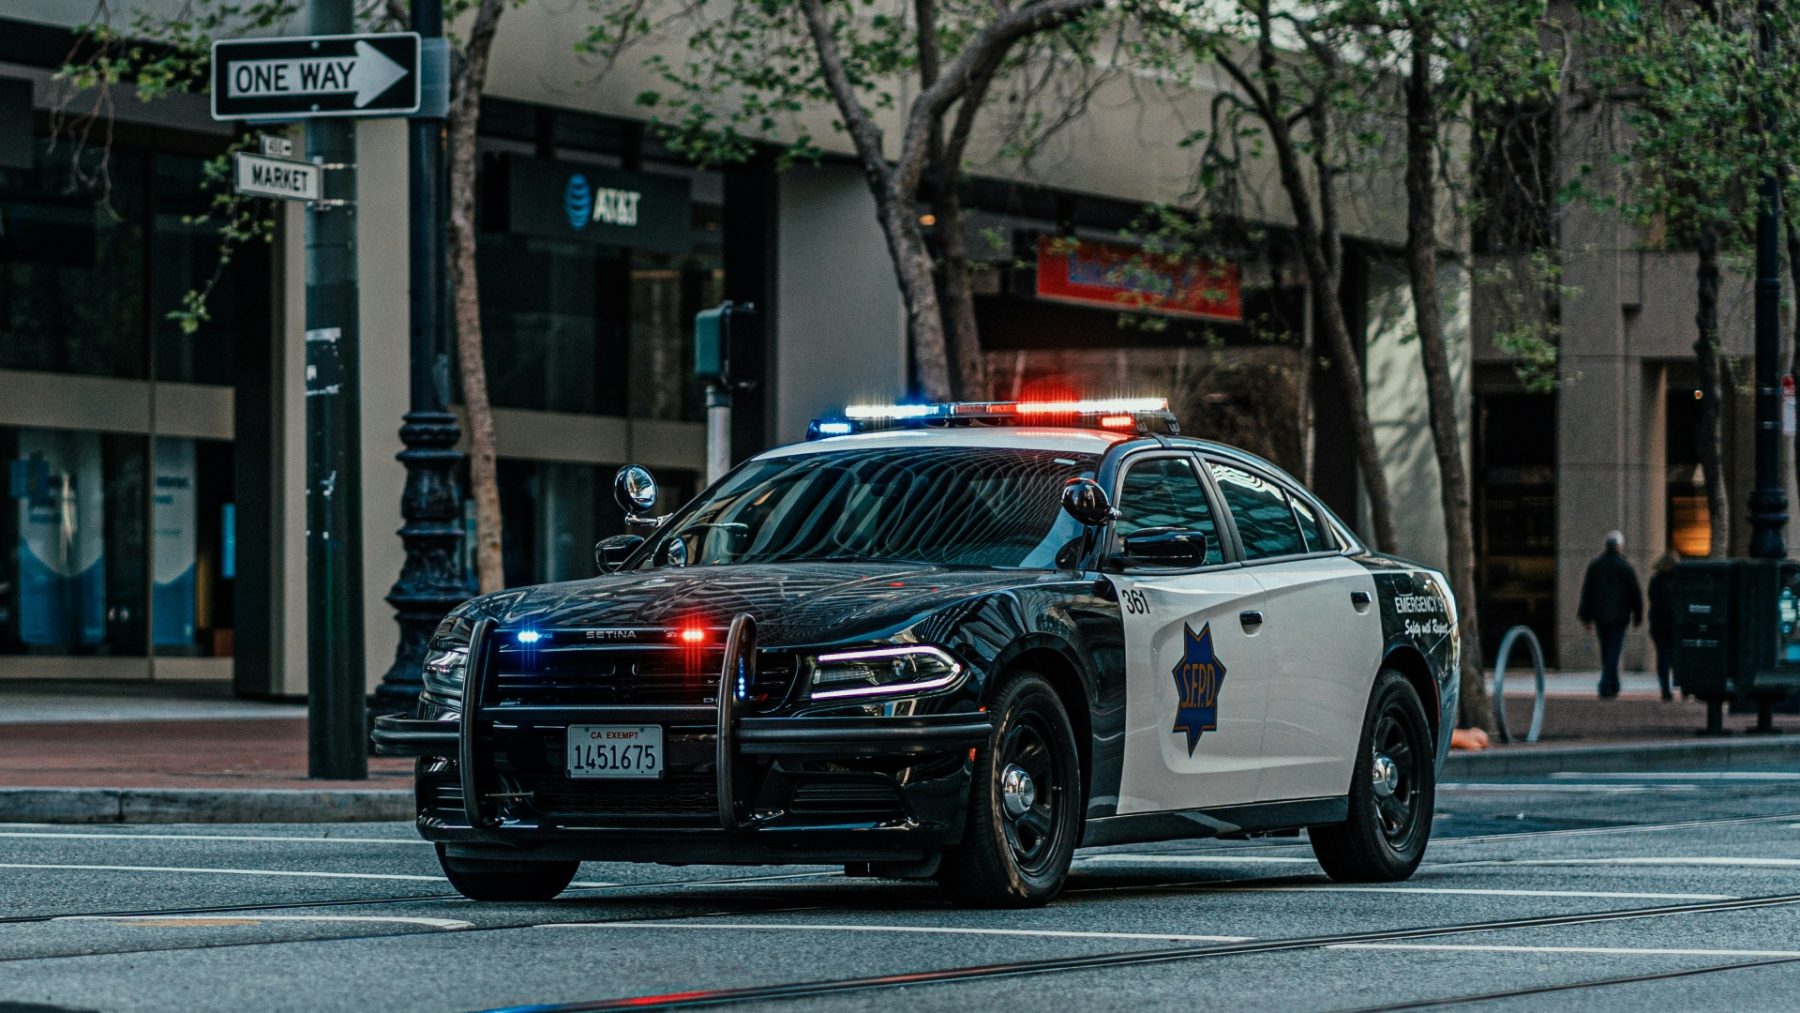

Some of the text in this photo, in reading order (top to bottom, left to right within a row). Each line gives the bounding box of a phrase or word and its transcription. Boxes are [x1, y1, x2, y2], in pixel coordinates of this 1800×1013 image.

[236, 61, 355, 93] ONE WAY
[252, 162, 308, 193] MARKET
[592, 187, 641, 227] AT&T
[1122, 589, 1150, 615] 361
[1394, 596, 1437, 613] EMERGENCY
[585, 630, 637, 639] SETINA
[1404, 618, 1421, 639] Safety
[1421, 618, 1432, 634] with
[590, 731, 640, 740] CA EXEMPT
[574, 744, 656, 770] 1451675
